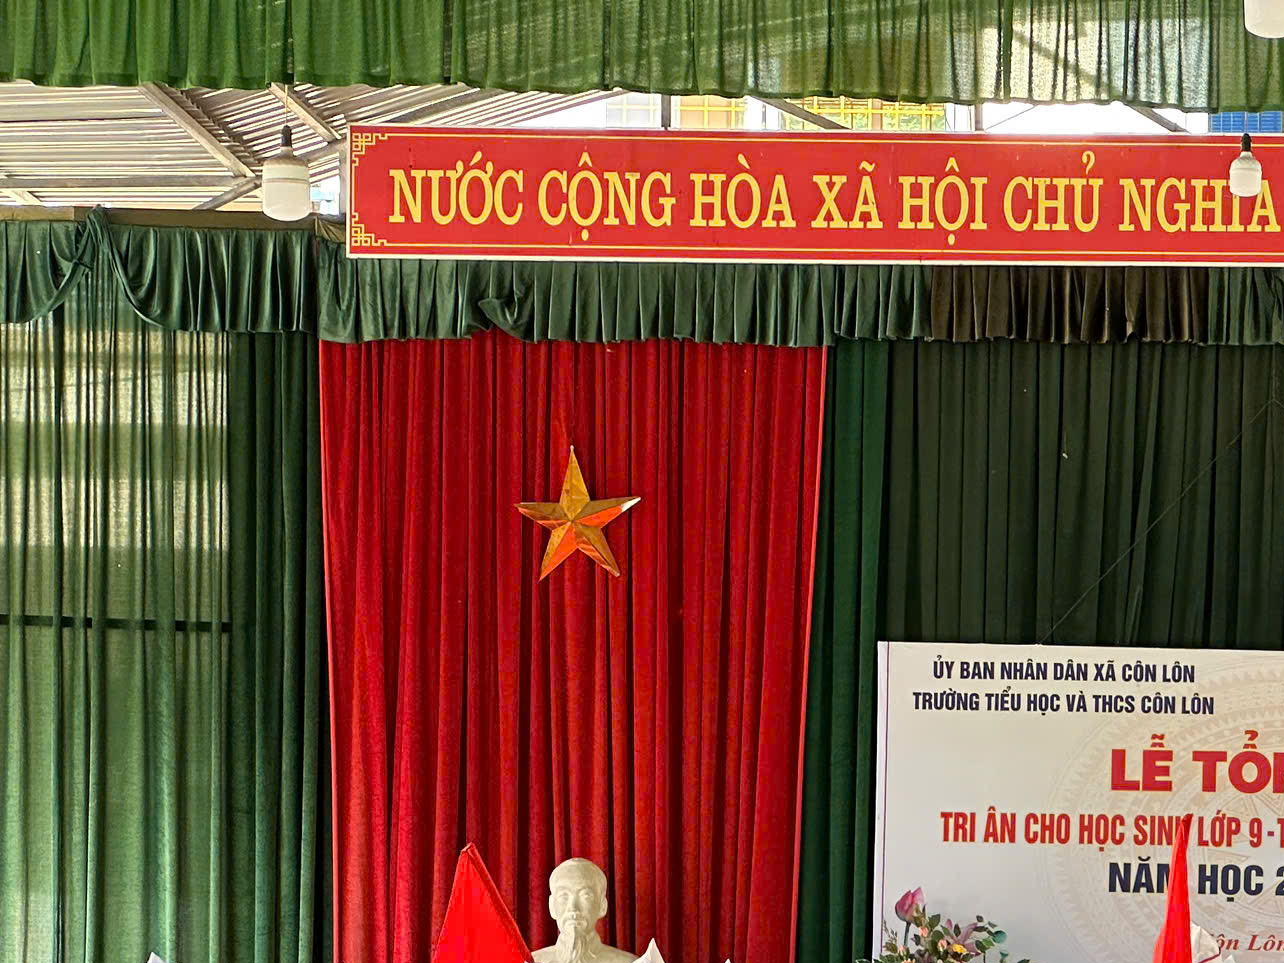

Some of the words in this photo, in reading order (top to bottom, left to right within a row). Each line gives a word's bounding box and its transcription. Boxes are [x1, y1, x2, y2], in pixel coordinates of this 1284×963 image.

[389, 161, 527, 226] NƯỚC
[538, 151, 676, 242] CỘNG
[690, 154, 797, 229] HÒA
[811, 161, 884, 229] XÃ
[898, 157, 988, 246] HỘI
[1004, 151, 1104, 232] CHỦ
[933, 655, 955, 679] ỦY
[959, 661, 995, 680] BAN
[1000, 658, 1048, 681] NHÂN
[1053, 659, 1088, 682] DÂN
[1093, 660, 1116, 682] XÃ
[1121, 660, 1157, 683] CÔN
[1162, 661, 1195, 683] LÔN
[912, 688, 980, 711] TRƯỜNG
[984, 685, 1021, 712] TIỂU
[1026, 693, 1061, 716] HỌC
[1065, 690, 1088, 713] VÀ
[1092, 695, 1135, 714] THCS
[1141, 692, 1176, 714] CÔN
[1181, 693, 1214, 715] LÔN
[1110, 733, 1173, 792] LỄ
[940, 811, 976, 843] TRI
[983, 806, 1017, 844] ÂN
[1024, 813, 1071, 845] CHO
[1078, 813, 1126, 852] HỌC
[1197, 809, 1241, 848] LỚP
[1197, 864, 1264, 903] HỌC
[1211, 933, 1240, 951] ôn
